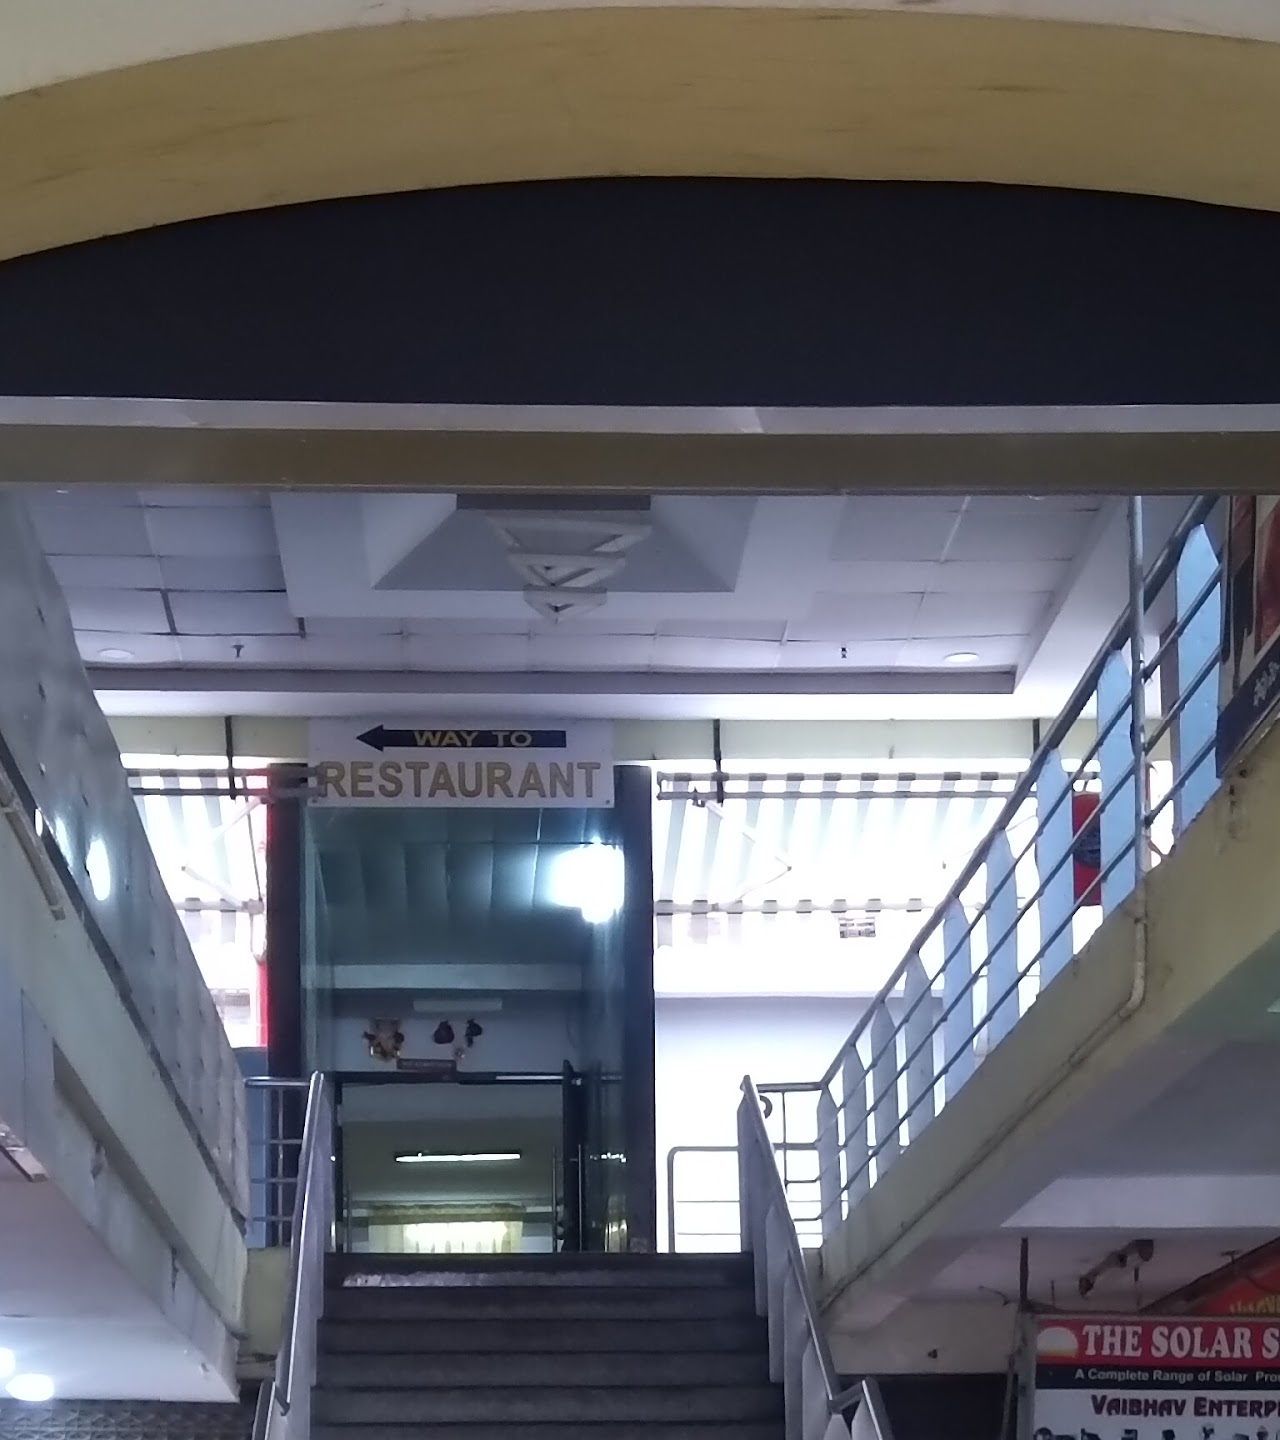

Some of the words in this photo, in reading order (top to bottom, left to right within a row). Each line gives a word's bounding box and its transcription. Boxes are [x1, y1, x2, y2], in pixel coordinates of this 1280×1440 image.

[415, 731, 480, 747] WAY
[492, 731, 533, 747] TO
[319, 761, 601, 798] RESTAURANT
[1082, 1324, 1143, 1357] THE
[1151, 1325, 1253, 1359] SOLAR
[1074, 1368, 1086, 1380] A
[1087, 1367, 1150, 1383] Complete
[1152, 1369, 1194, 1385] Range
[1197, 1370, 1211, 1382] of
[1214, 1370, 1248, 1383] Solar
[1090, 1394, 1187, 1418] VAIBHAV
